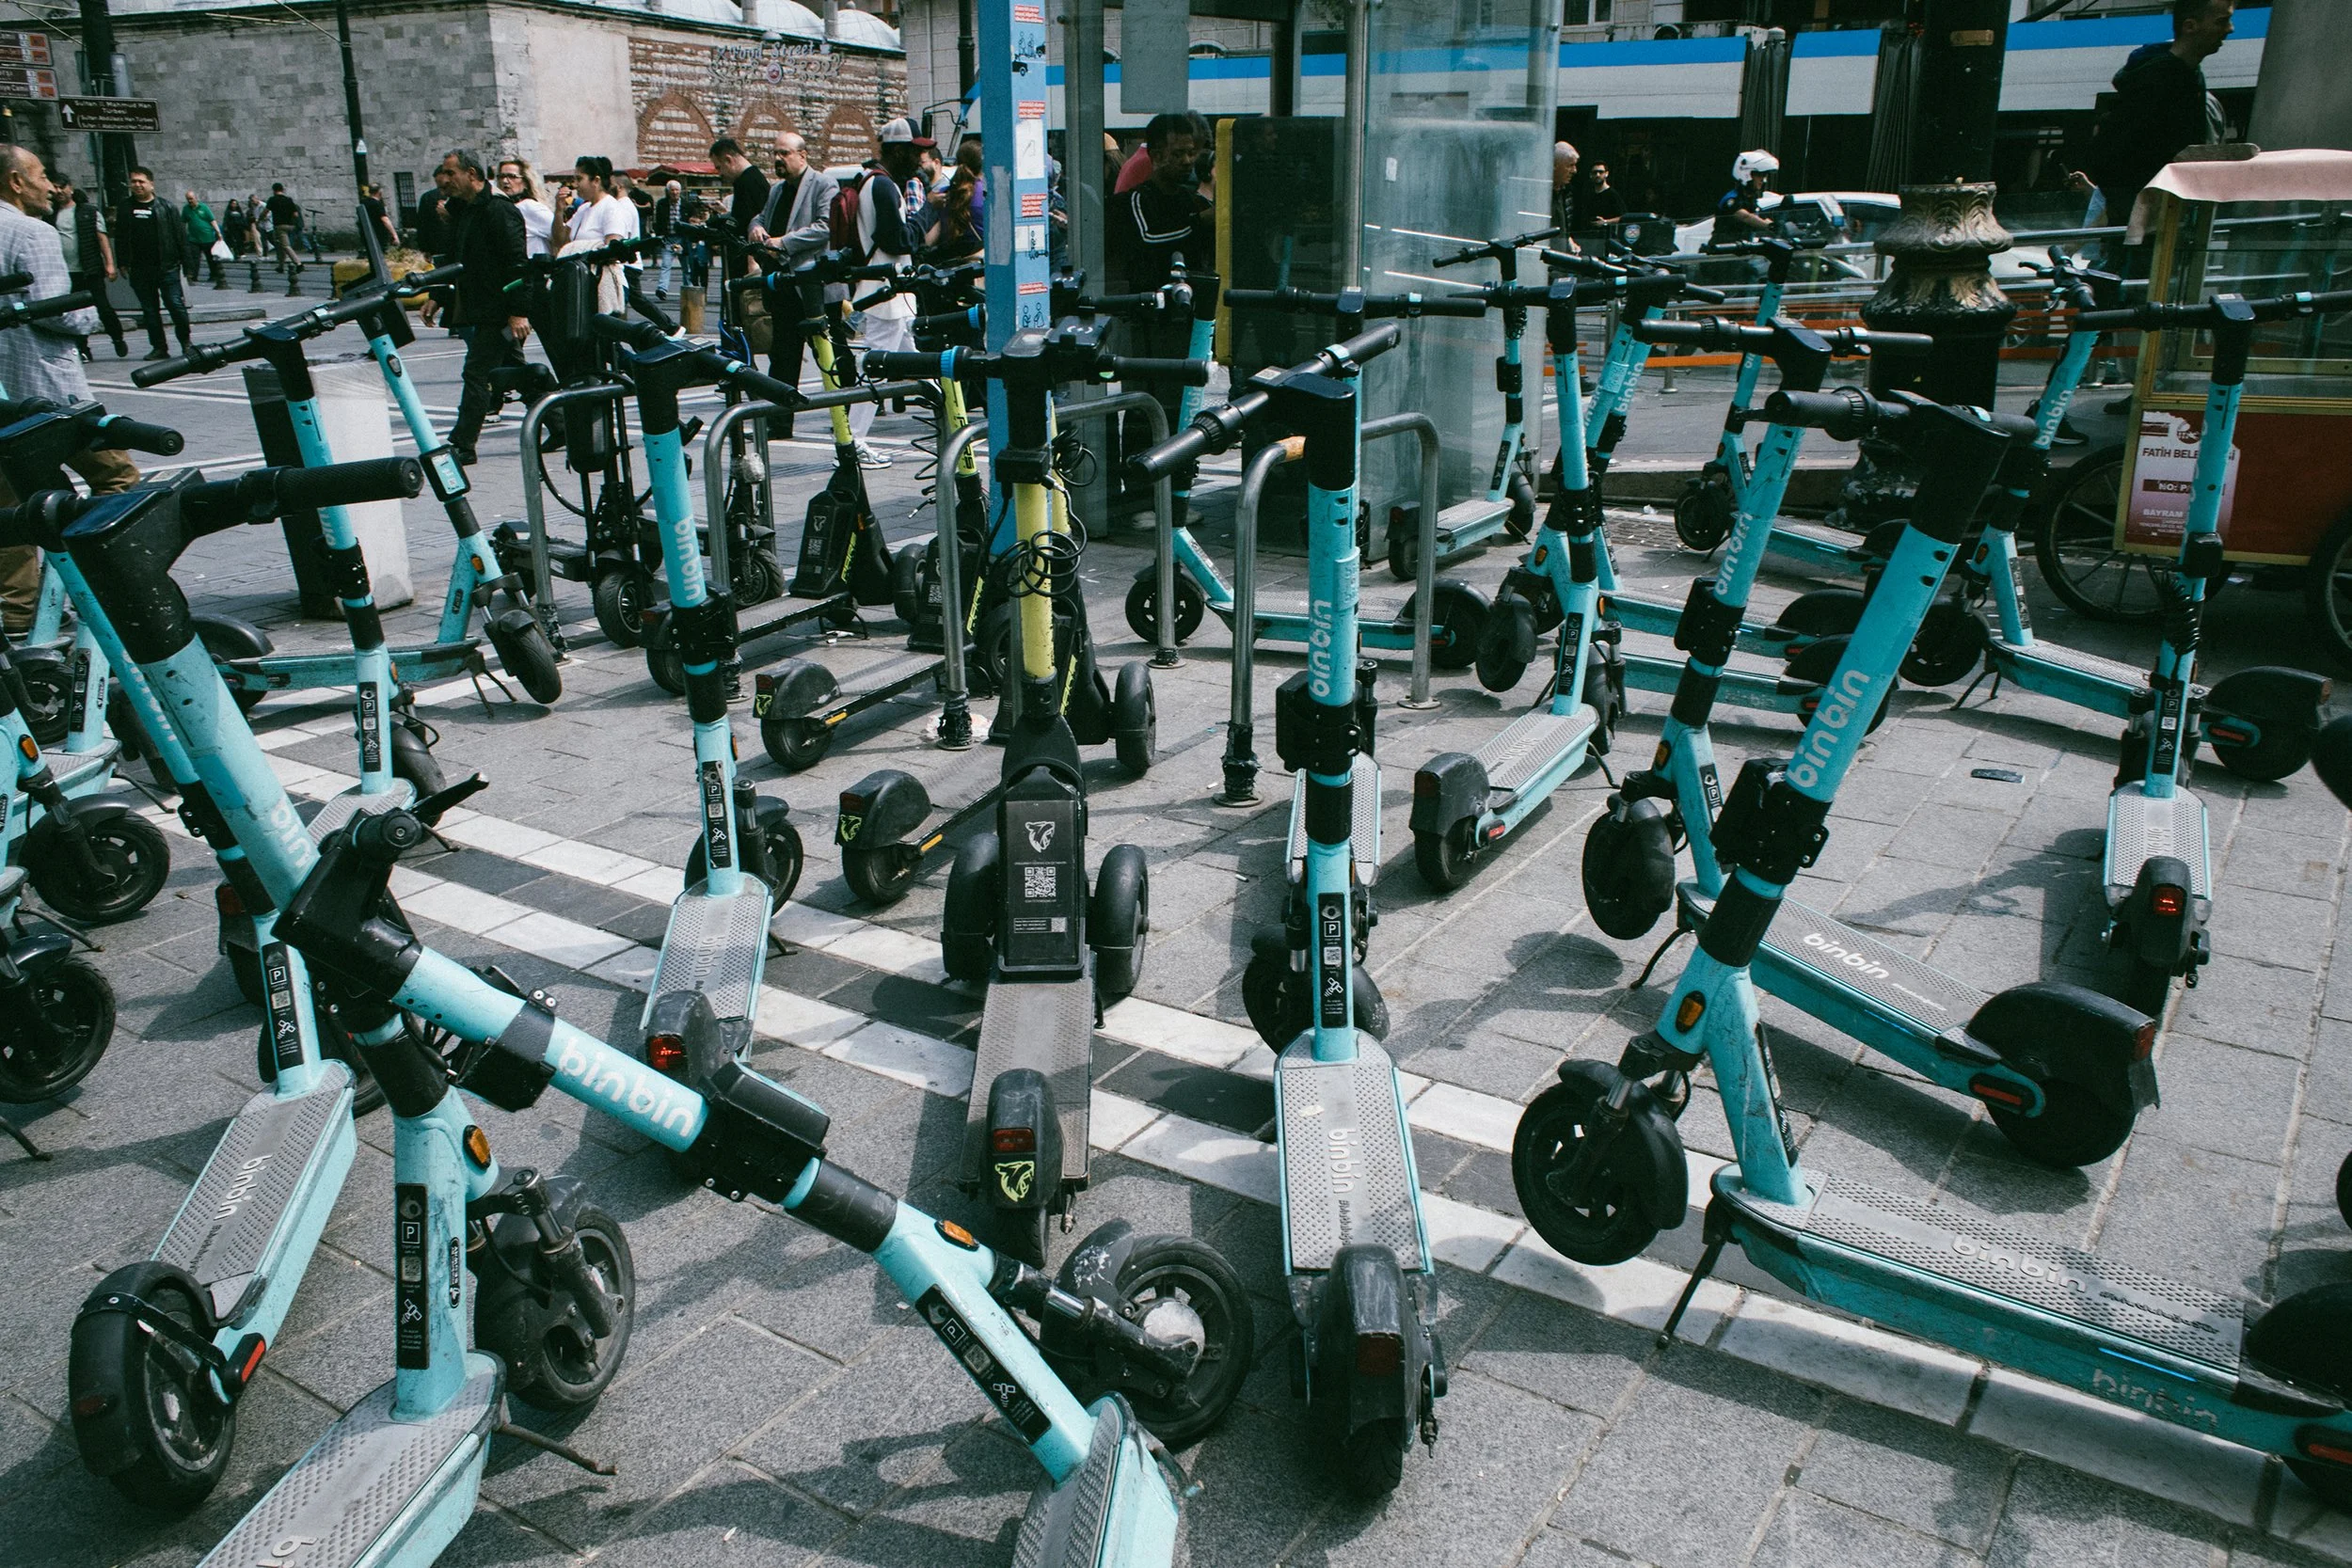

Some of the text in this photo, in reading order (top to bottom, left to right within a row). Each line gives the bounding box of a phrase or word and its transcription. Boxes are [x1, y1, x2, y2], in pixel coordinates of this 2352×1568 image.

[771, 41, 815, 57] Street
[1614, 362, 1644, 412] binbin
[2034, 389, 2073, 446] binbin
[2142, 446, 2172, 458] FATİH
[2143, 509, 2184, 518] BAYRAM
[675, 515, 701, 601] binbin
[1310, 599, 1331, 697] binbin
[1788, 670, 1870, 788] binbin
[694, 936, 725, 978] binbin
[1804, 933, 1889, 980] binbin
[558, 1037, 694, 1138] binbin
[213, 1154, 273, 1220] binbin
[1327, 1128, 1361, 1194] binbin
[1952, 1235, 2086, 1293] binbin
